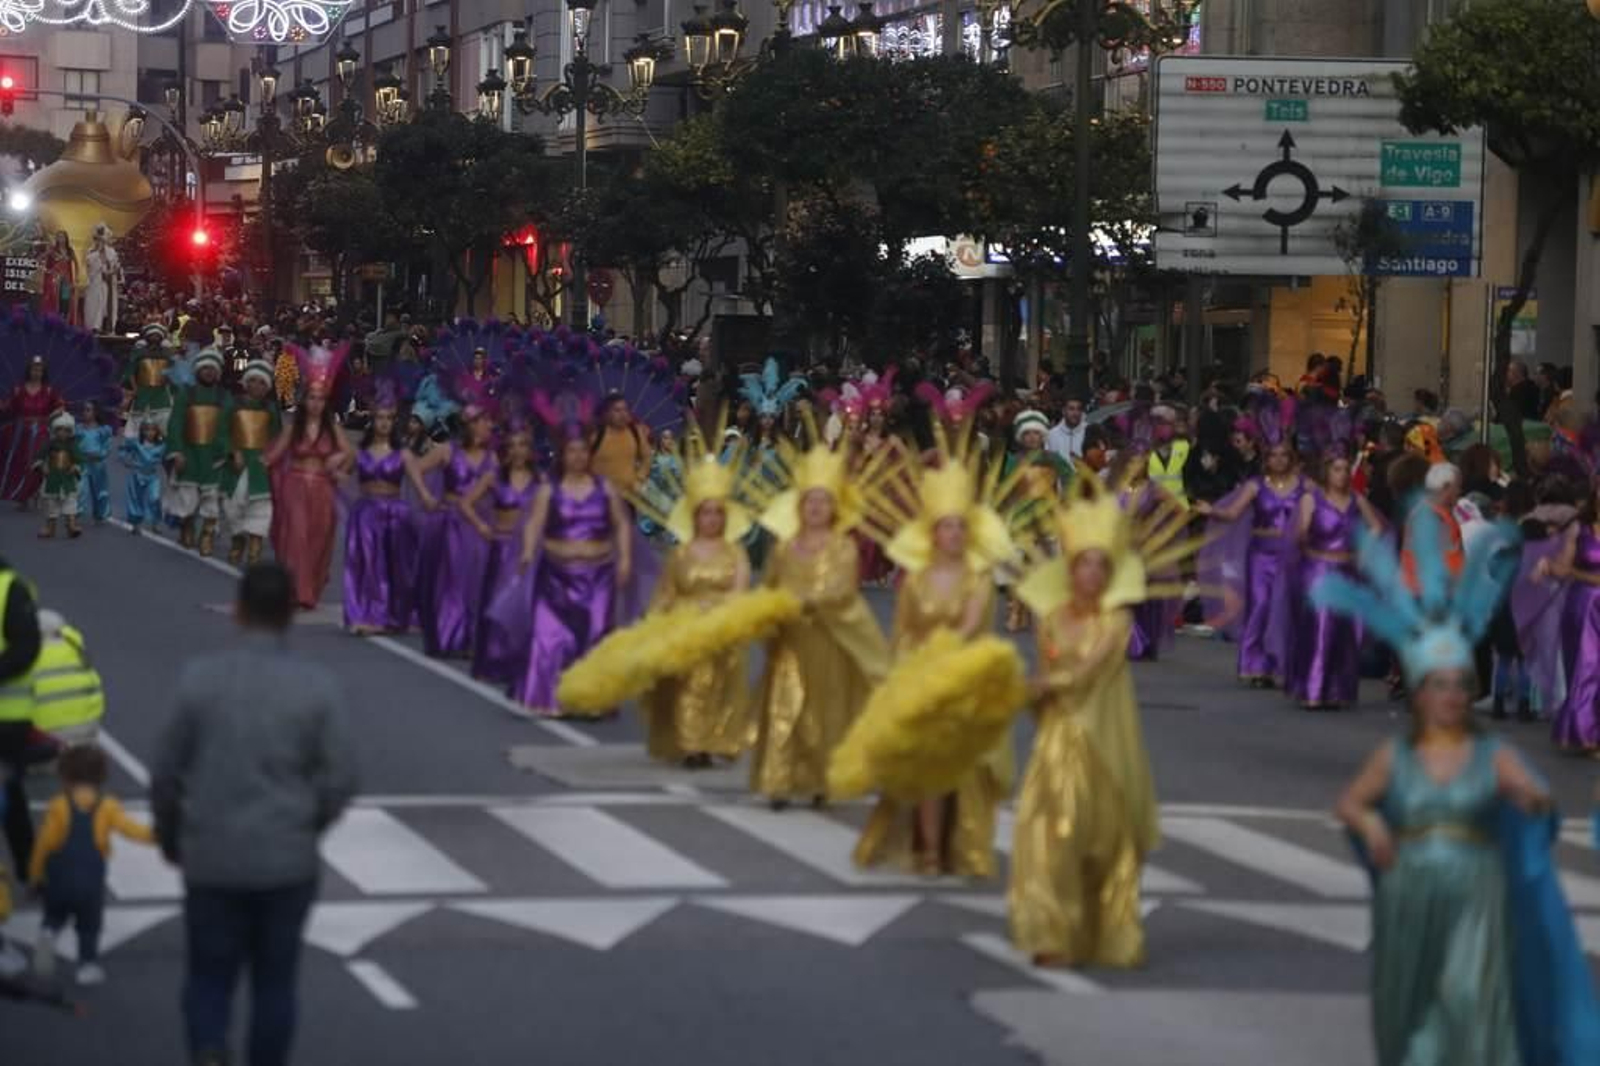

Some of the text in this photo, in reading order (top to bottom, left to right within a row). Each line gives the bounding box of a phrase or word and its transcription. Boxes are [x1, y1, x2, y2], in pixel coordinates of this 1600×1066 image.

[1234, 78, 1370, 97] PONTEVEDRA
[1270, 102, 1303, 119] Teis
[1386, 165, 1454, 184] de Vigo
[1387, 205, 1451, 218] E-1 A-9
[1377, 257, 1459, 274] Santiago
